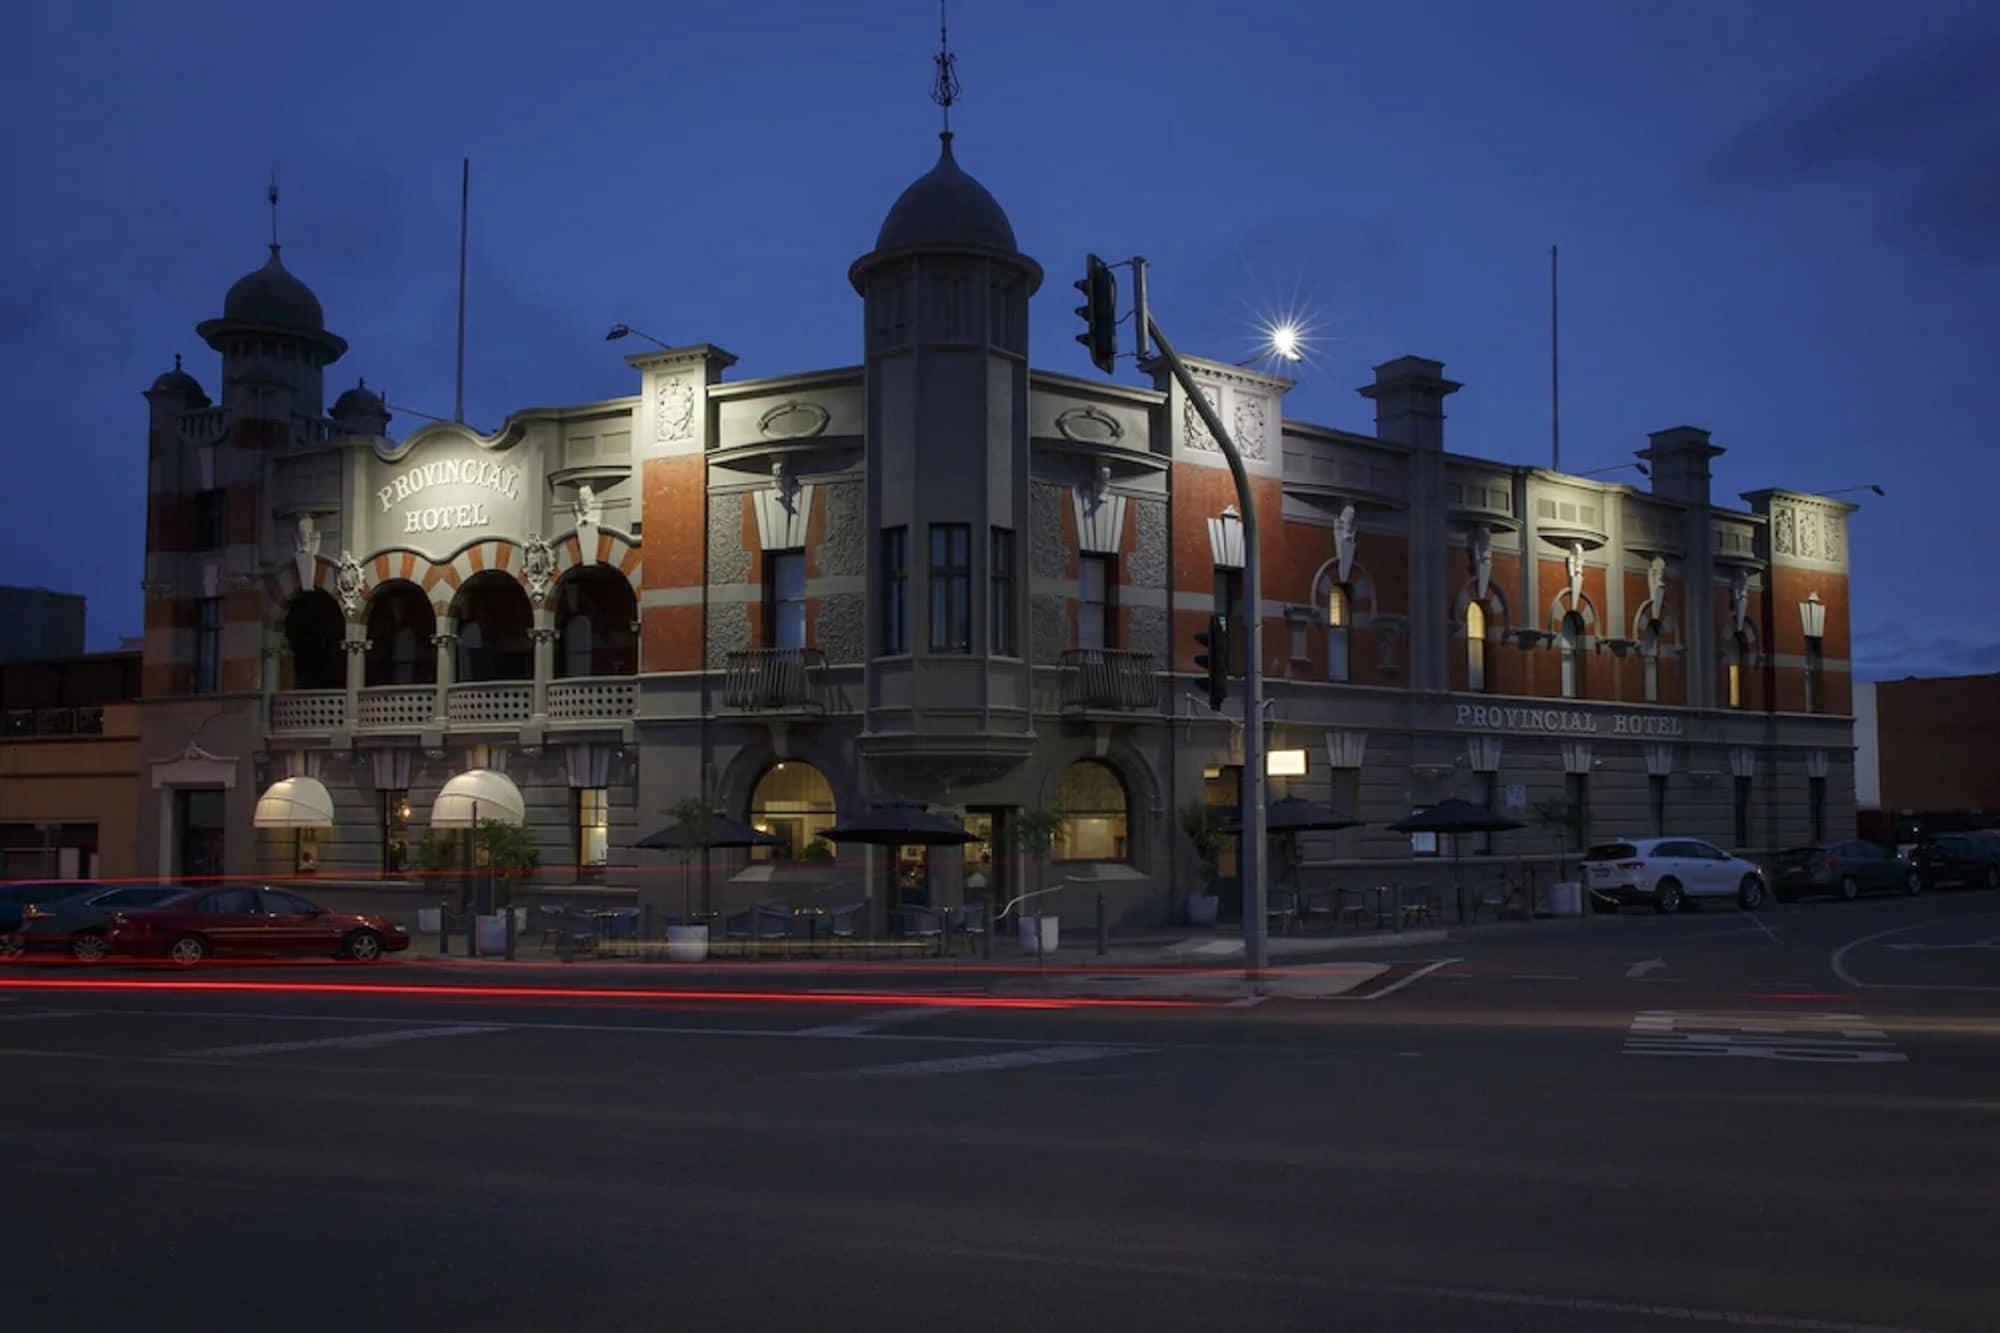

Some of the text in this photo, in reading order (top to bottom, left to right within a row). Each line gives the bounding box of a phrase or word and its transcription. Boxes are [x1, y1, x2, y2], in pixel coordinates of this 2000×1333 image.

[377, 459, 520, 512] PROVINCIAL
[404, 503, 489, 534] HOTEL
[1455, 704, 1682, 735] PROVINCIAL HOTEL
